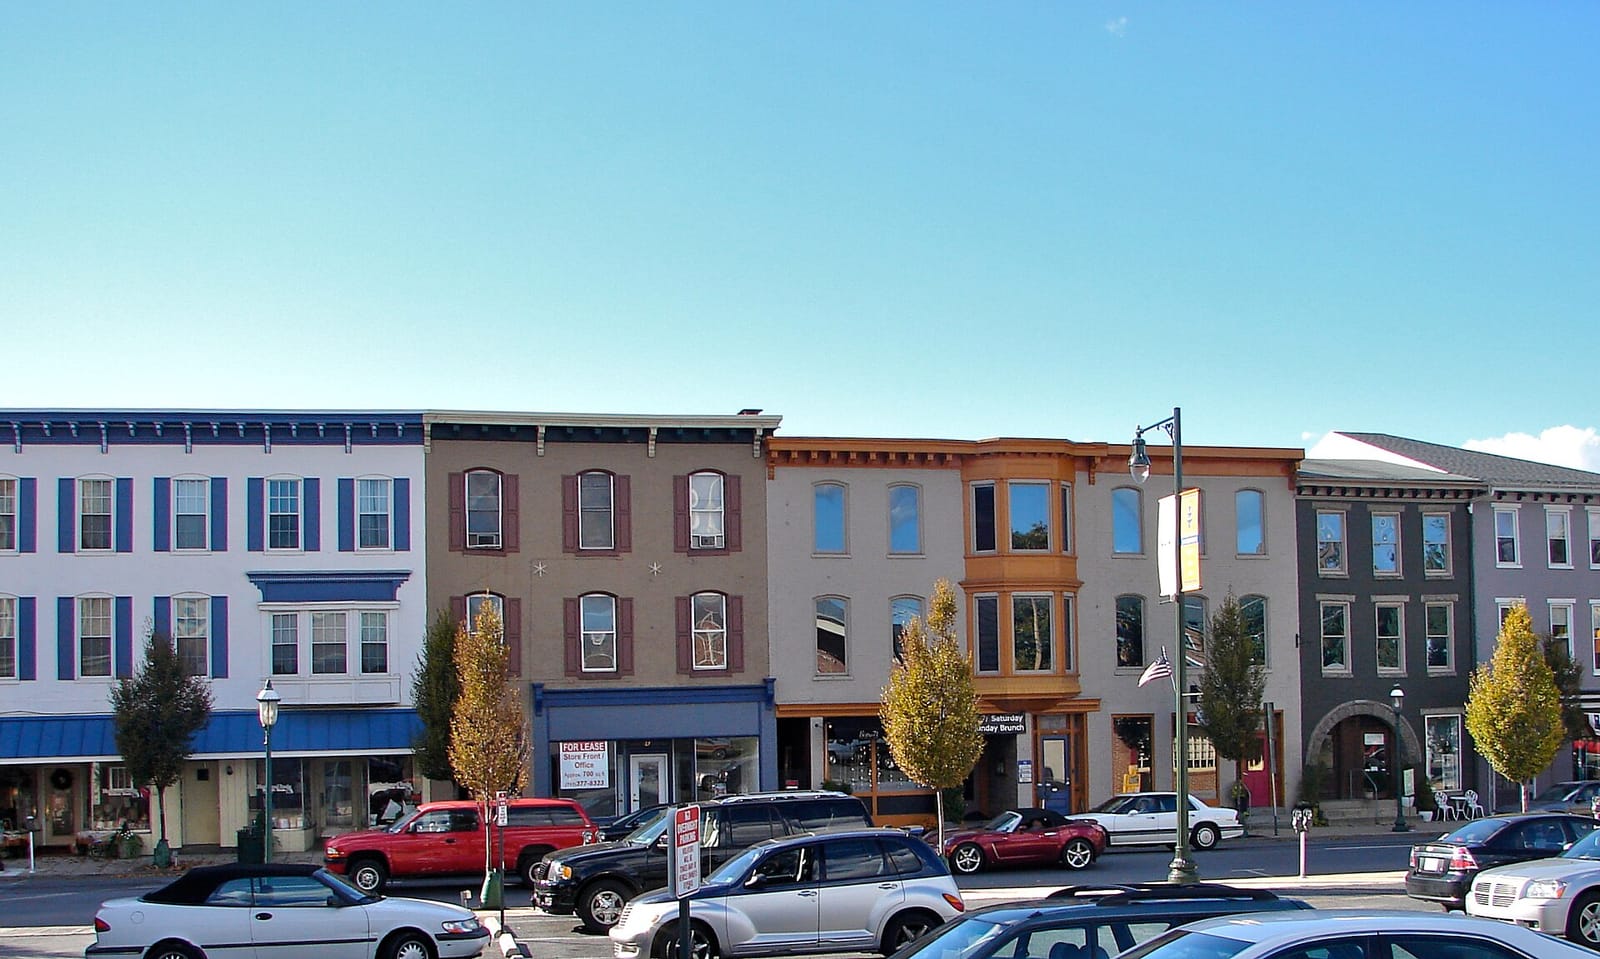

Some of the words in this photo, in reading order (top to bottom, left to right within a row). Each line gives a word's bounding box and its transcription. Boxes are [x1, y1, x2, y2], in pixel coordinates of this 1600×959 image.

[976, 724, 998, 733] unday
[1000, 724, 1024, 732] Brunch
[563, 743, 578, 752] FOR
[580, 742, 604, 751] LEASE
